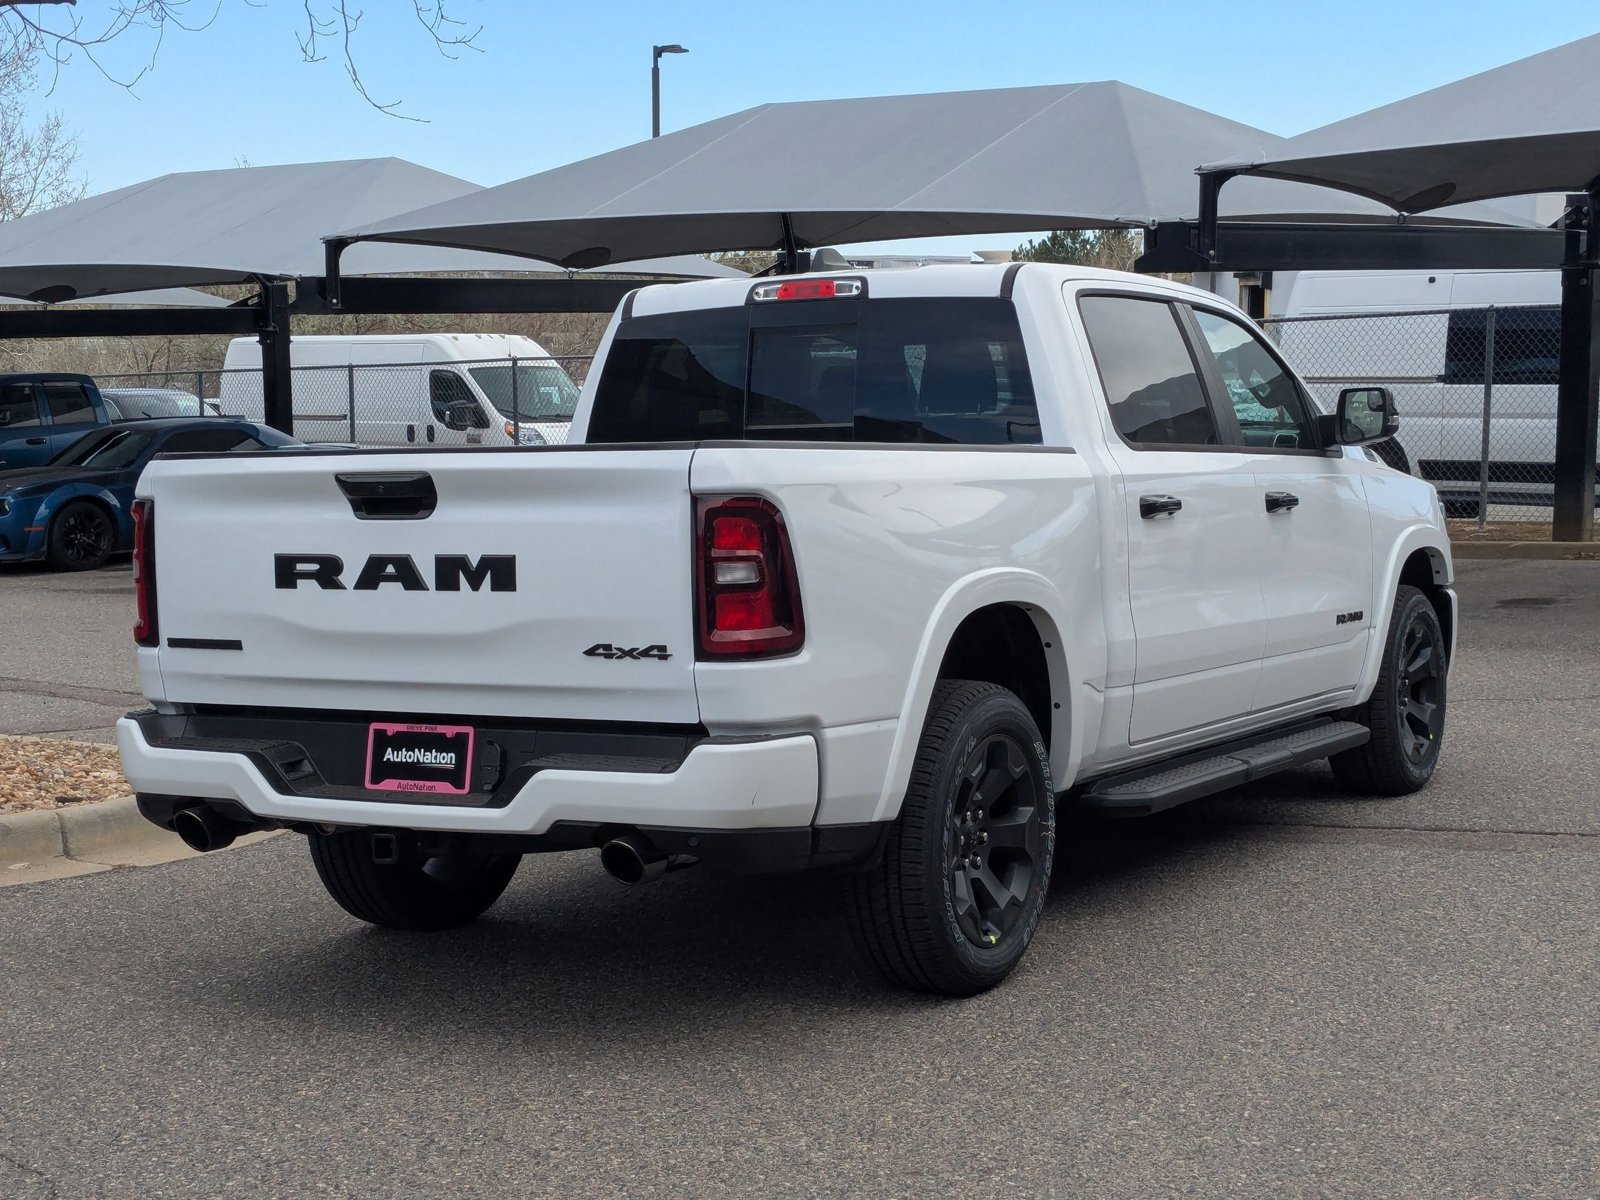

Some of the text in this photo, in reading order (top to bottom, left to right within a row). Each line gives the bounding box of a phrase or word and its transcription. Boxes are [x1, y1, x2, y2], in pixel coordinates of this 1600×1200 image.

[274, 553, 517, 592] RAM
[1336, 610, 1363, 625] RAM
[383, 747, 456, 764] AutoNation
[396, 782, 437, 792] AutoNation
